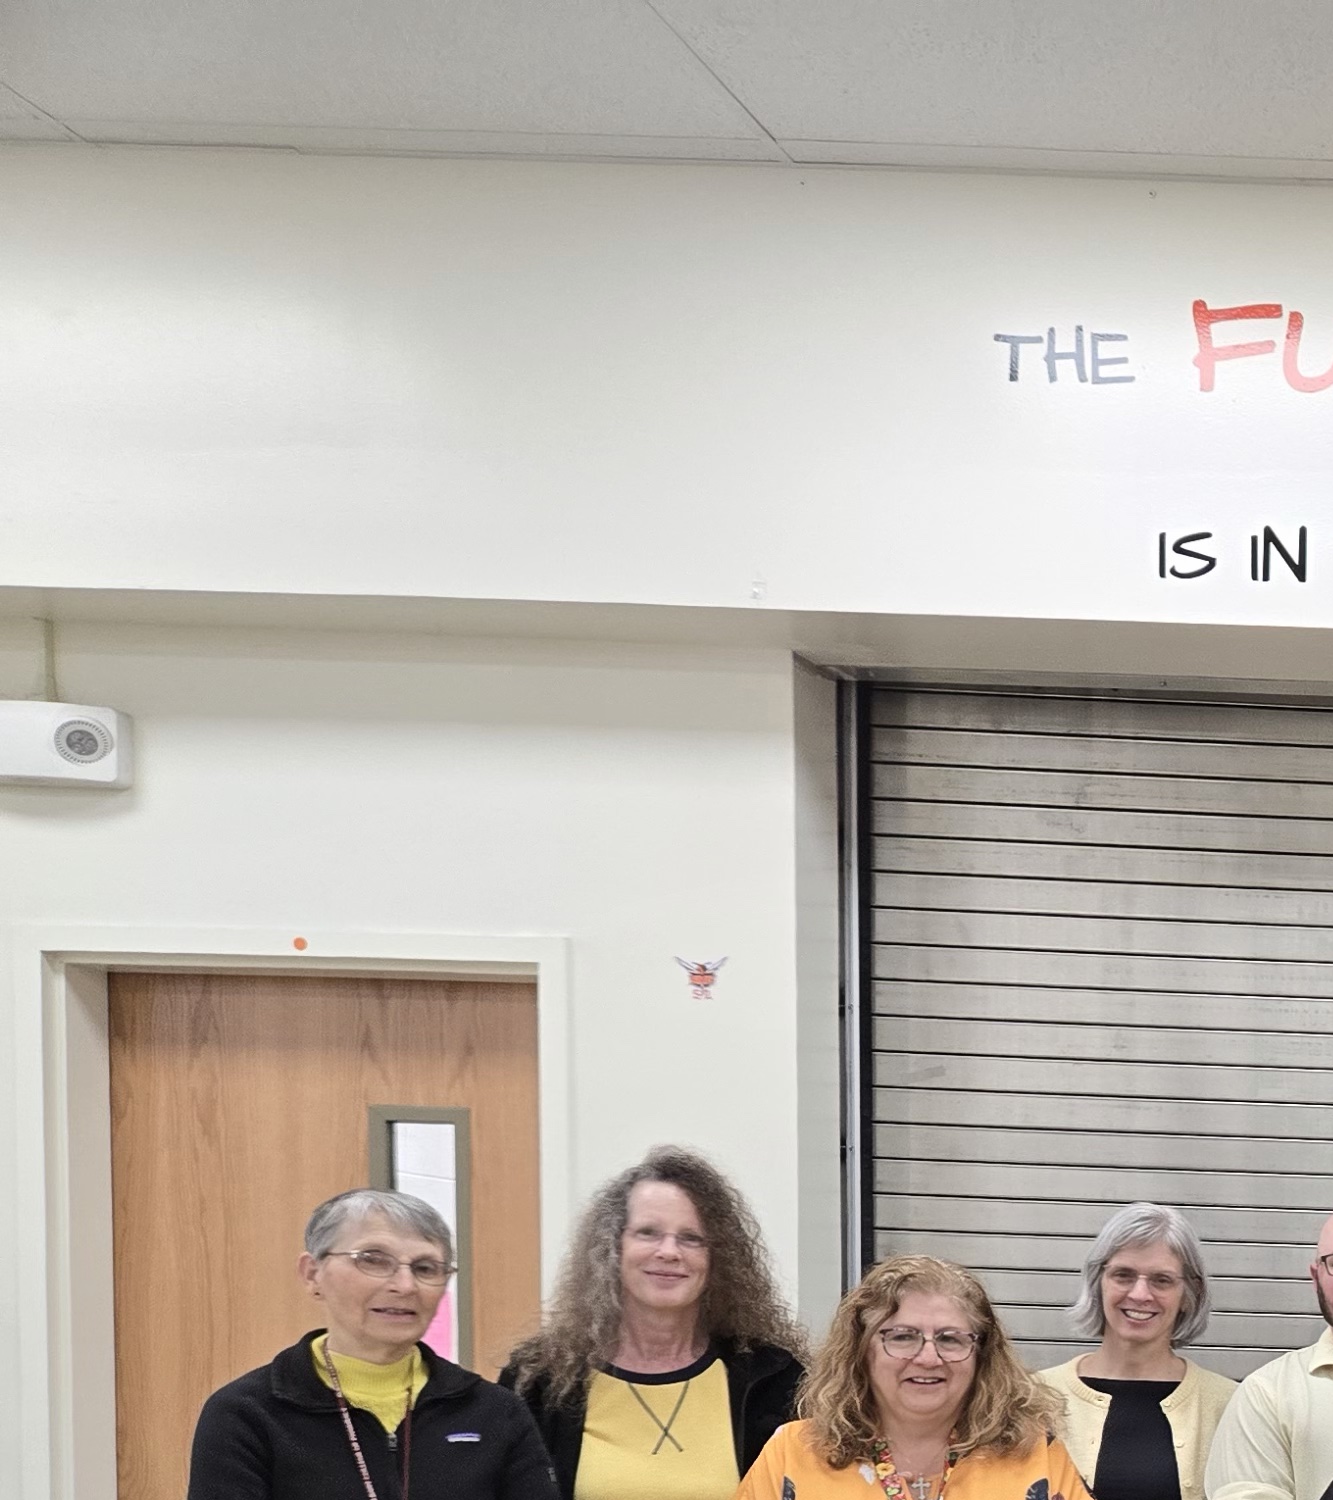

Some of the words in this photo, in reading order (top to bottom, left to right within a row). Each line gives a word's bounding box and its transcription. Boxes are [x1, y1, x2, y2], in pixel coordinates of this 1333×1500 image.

[994, 325, 1135, 385] THE
[1158, 531, 1217, 580] IS
[1250, 525, 1308, 583] IN
